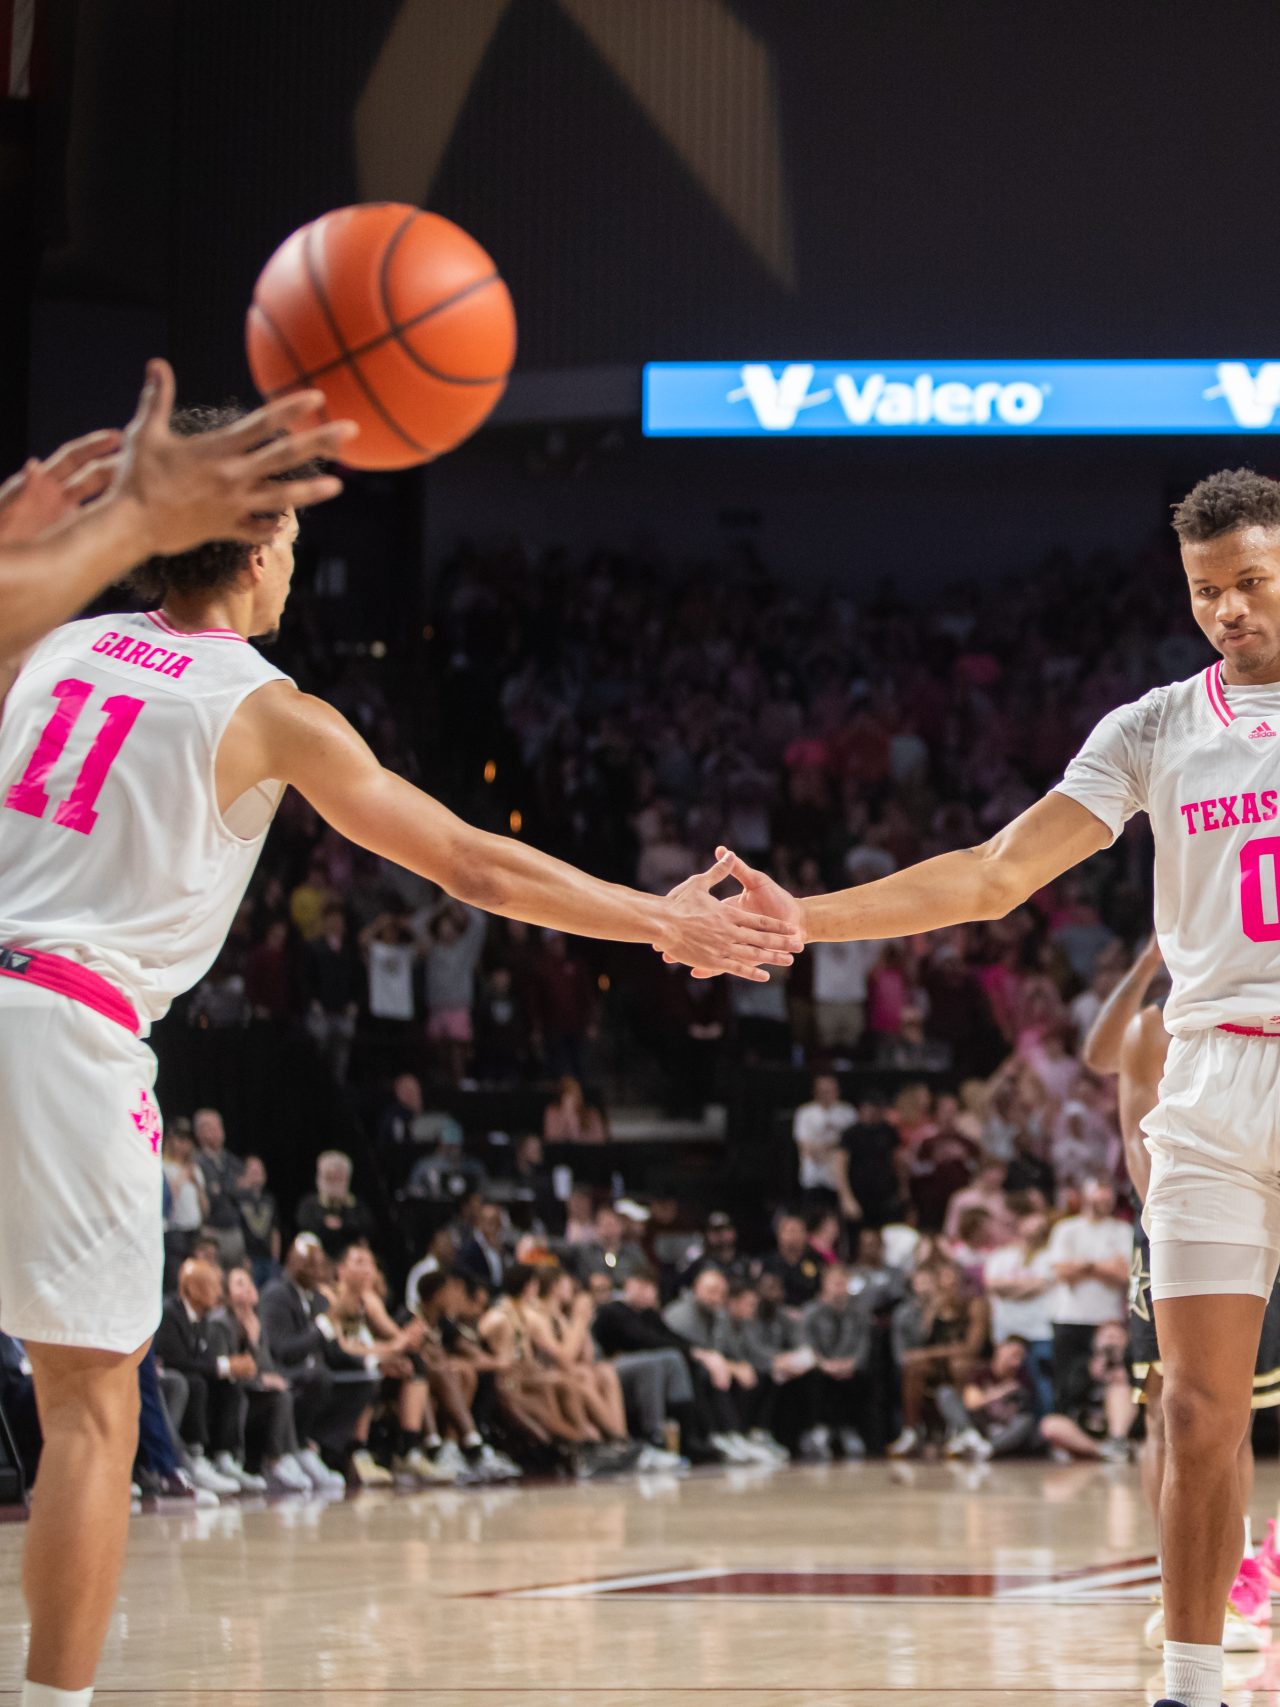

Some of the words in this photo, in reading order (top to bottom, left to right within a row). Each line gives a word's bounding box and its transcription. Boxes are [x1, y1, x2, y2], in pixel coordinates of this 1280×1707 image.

[834, 373, 1044, 425] Valero
[91, 631, 193, 679] GARCIA
[4, 678, 146, 836] 11
[1248, 731, 1277, 739] adidas
[1181, 790, 1279, 835] TEXAS
